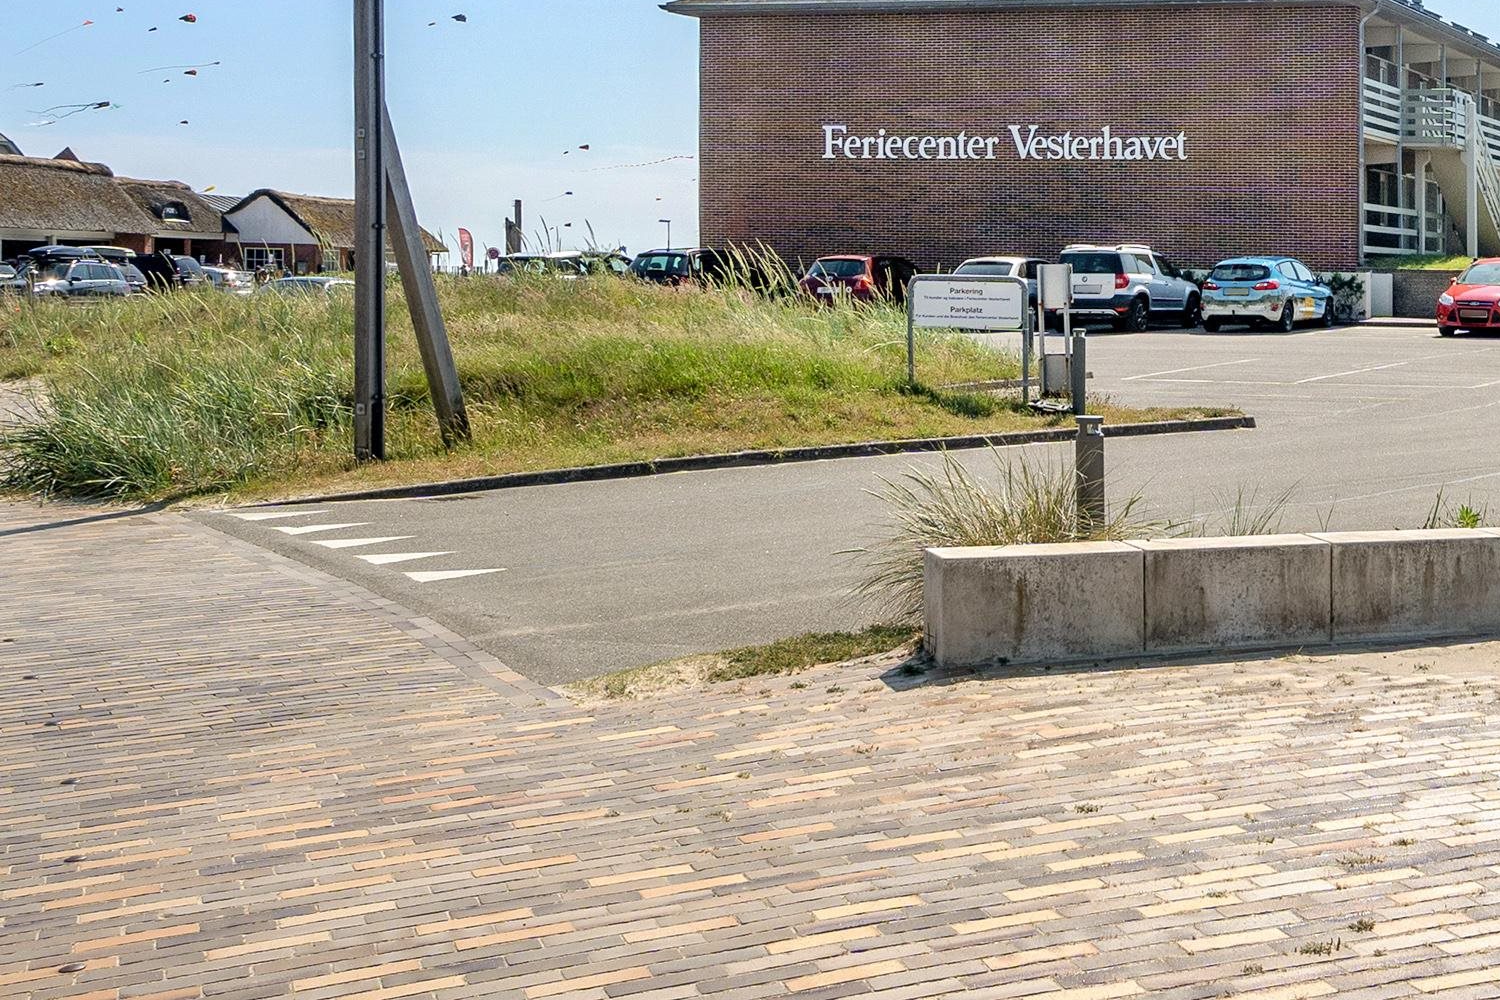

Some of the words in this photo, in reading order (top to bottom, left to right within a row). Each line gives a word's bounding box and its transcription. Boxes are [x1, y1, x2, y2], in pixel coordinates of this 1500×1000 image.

[821, 125, 1000, 160] Feriecenter
[1007, 125, 1188, 160] Vesterhavet
[949, 287, 984, 295] Parkering
[949, 306, 983, 314] Parkplatz
